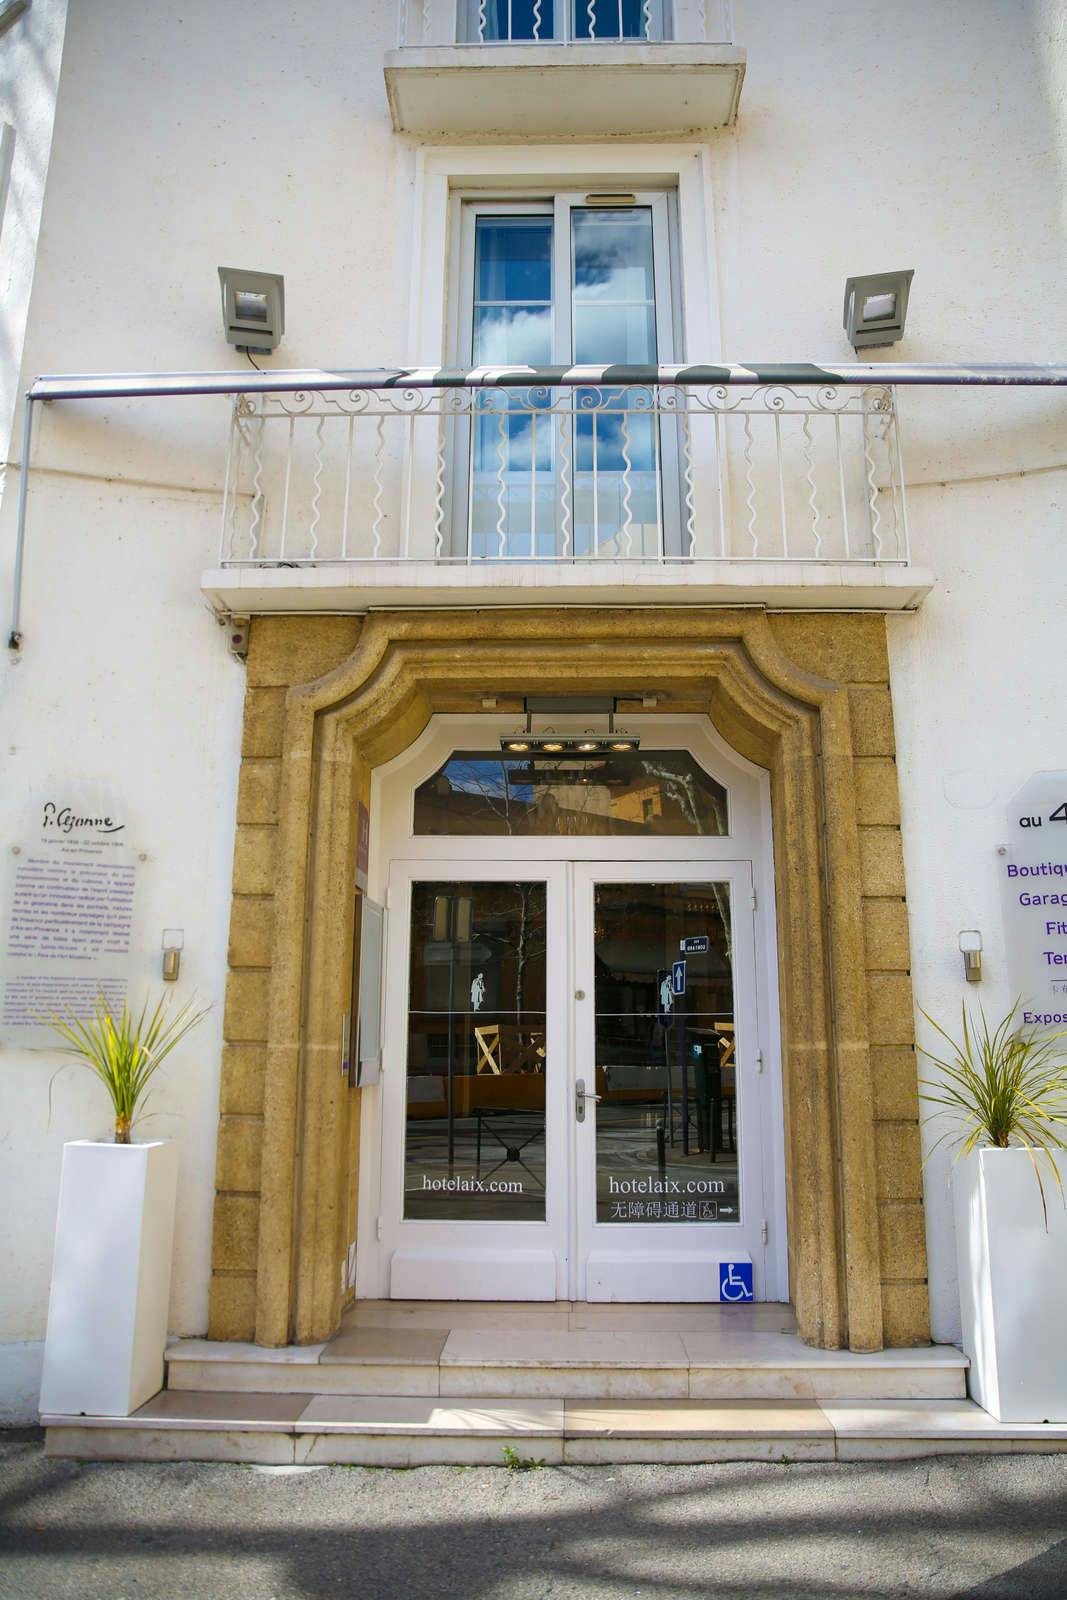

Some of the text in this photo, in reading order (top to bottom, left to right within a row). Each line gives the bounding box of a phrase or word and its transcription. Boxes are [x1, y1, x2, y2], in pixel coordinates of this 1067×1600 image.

[1019, 816, 1042, 828] au
[422, 1174, 524, 1193] hotelaix.com
[608, 1175, 726, 1193] hotelaix.com
[610, 1200, 698, 1219] 无障碍通道
